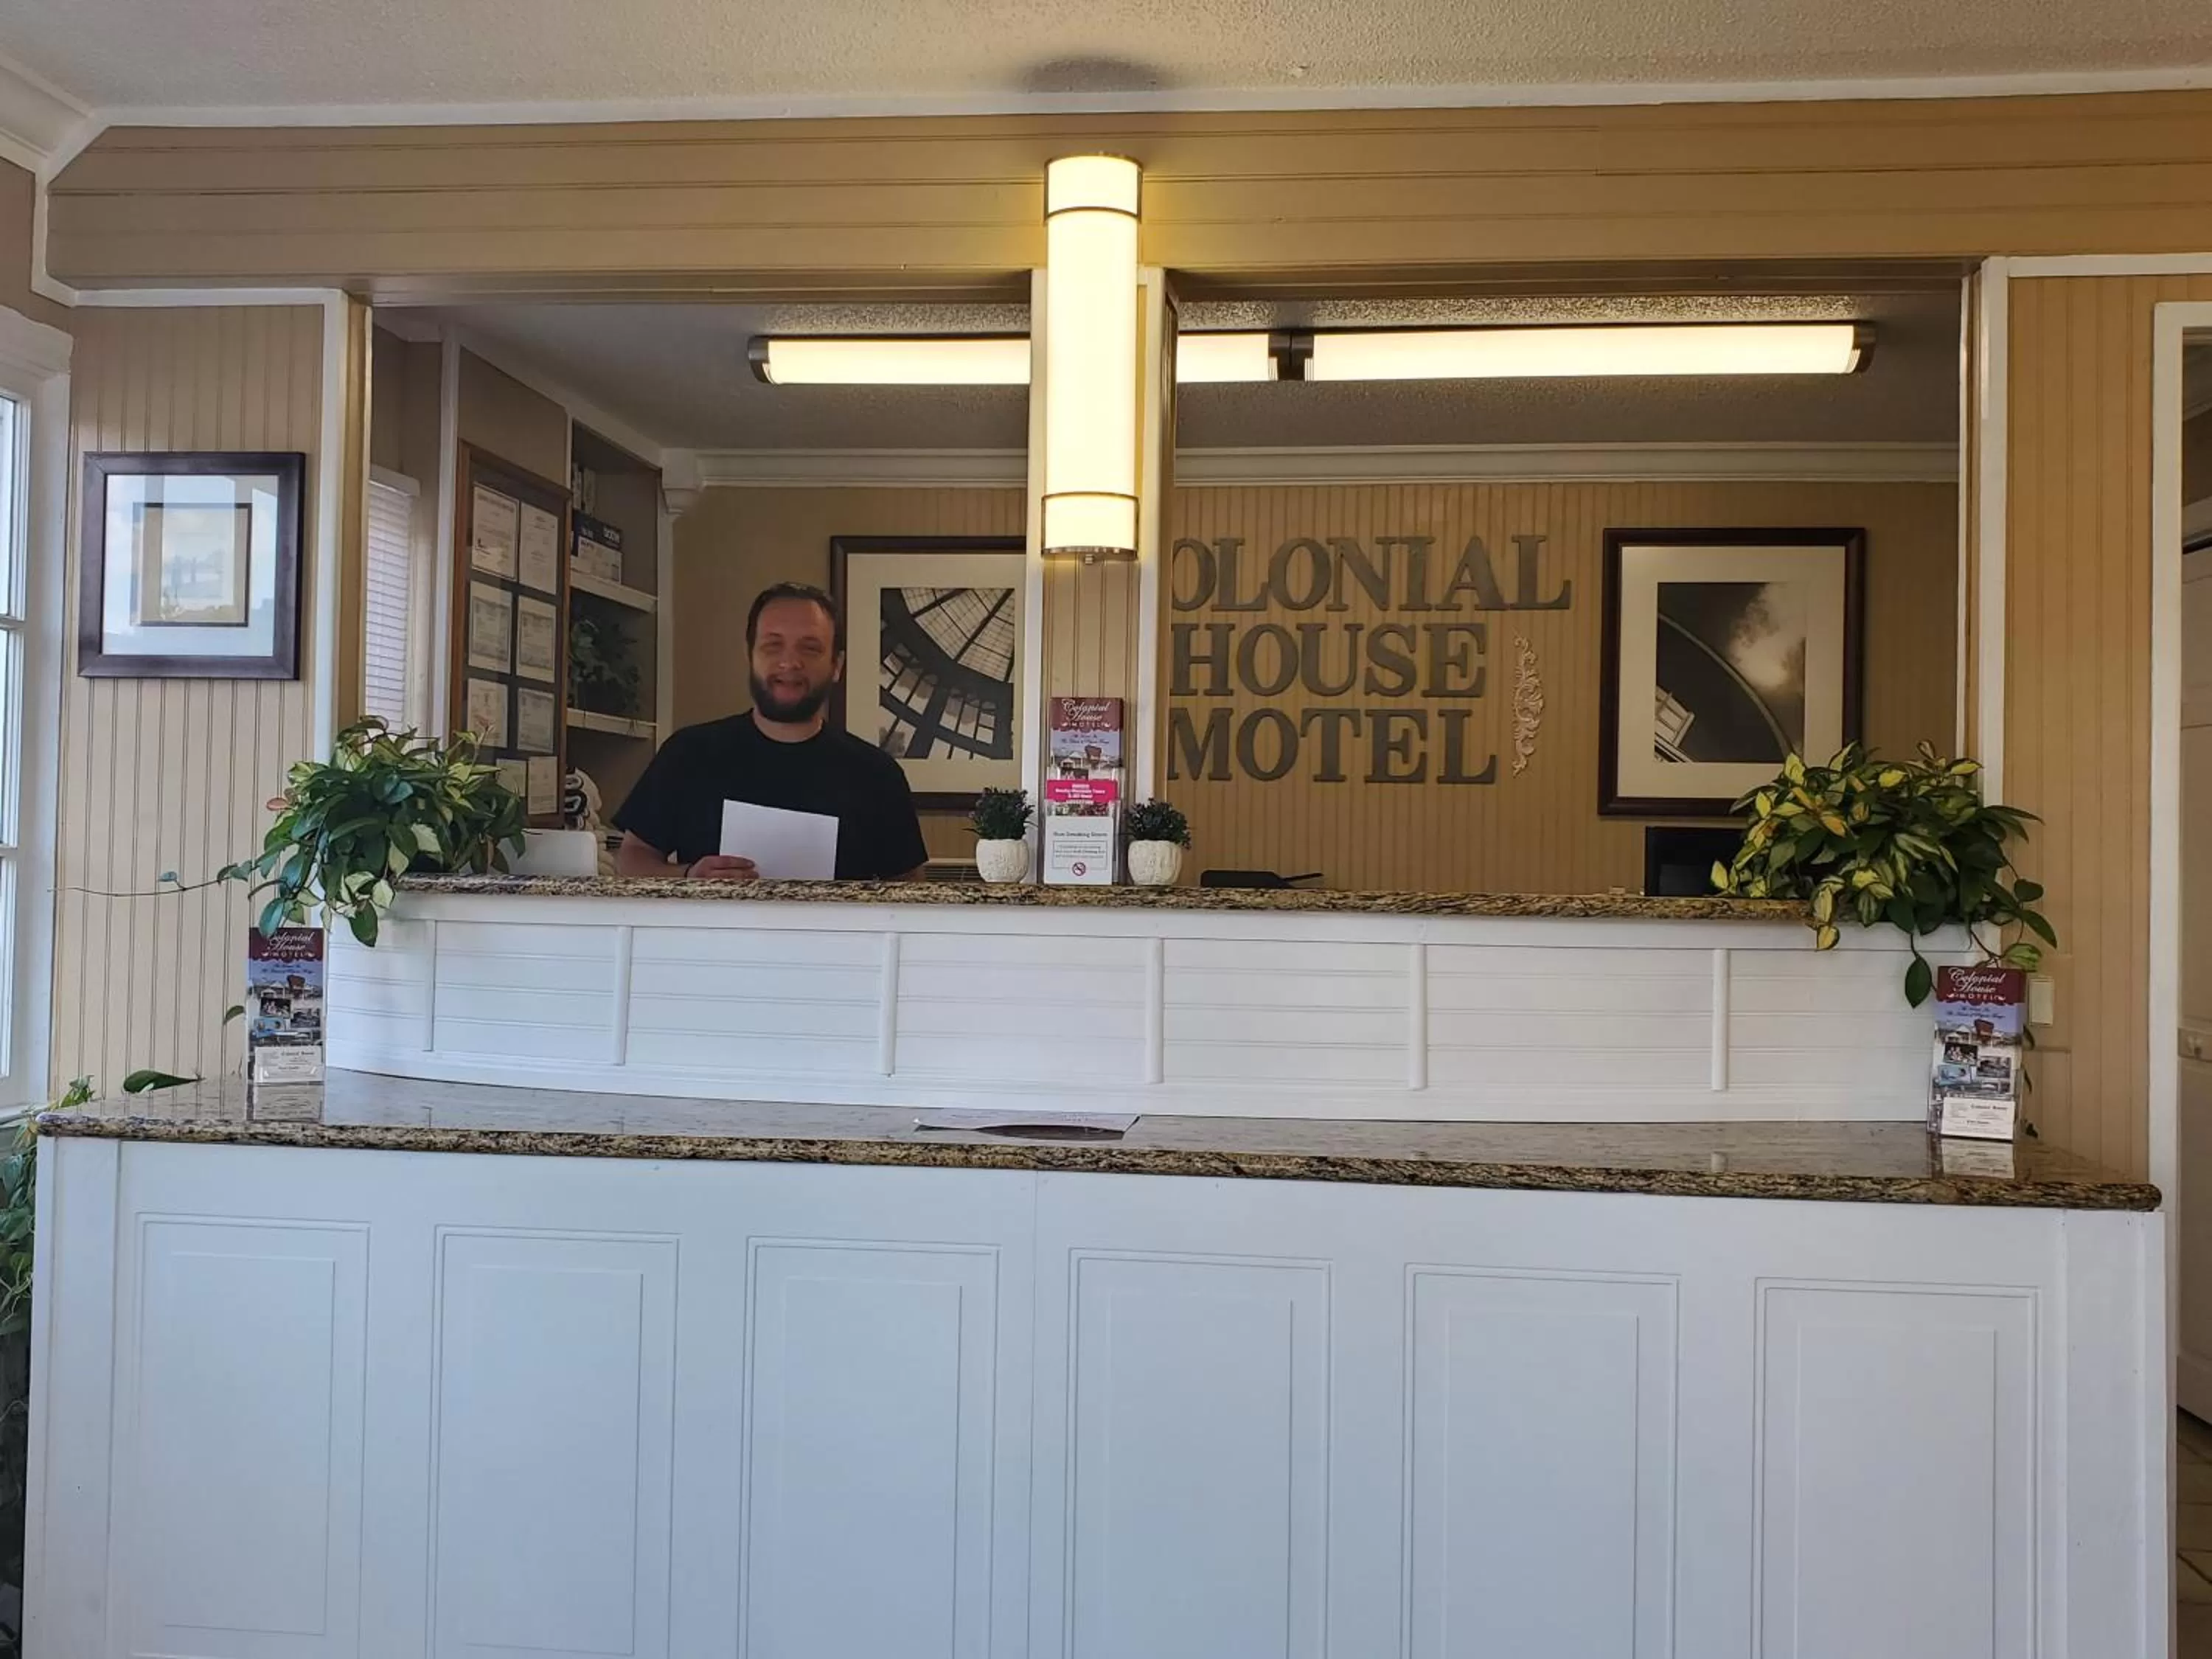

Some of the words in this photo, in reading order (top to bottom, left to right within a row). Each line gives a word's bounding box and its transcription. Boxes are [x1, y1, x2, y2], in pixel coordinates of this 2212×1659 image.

[1172, 535, 1572, 611] OLONIAL
[1169, 623, 1486, 698] HOUSE
[1166, 706, 1497, 785] MOTEL
